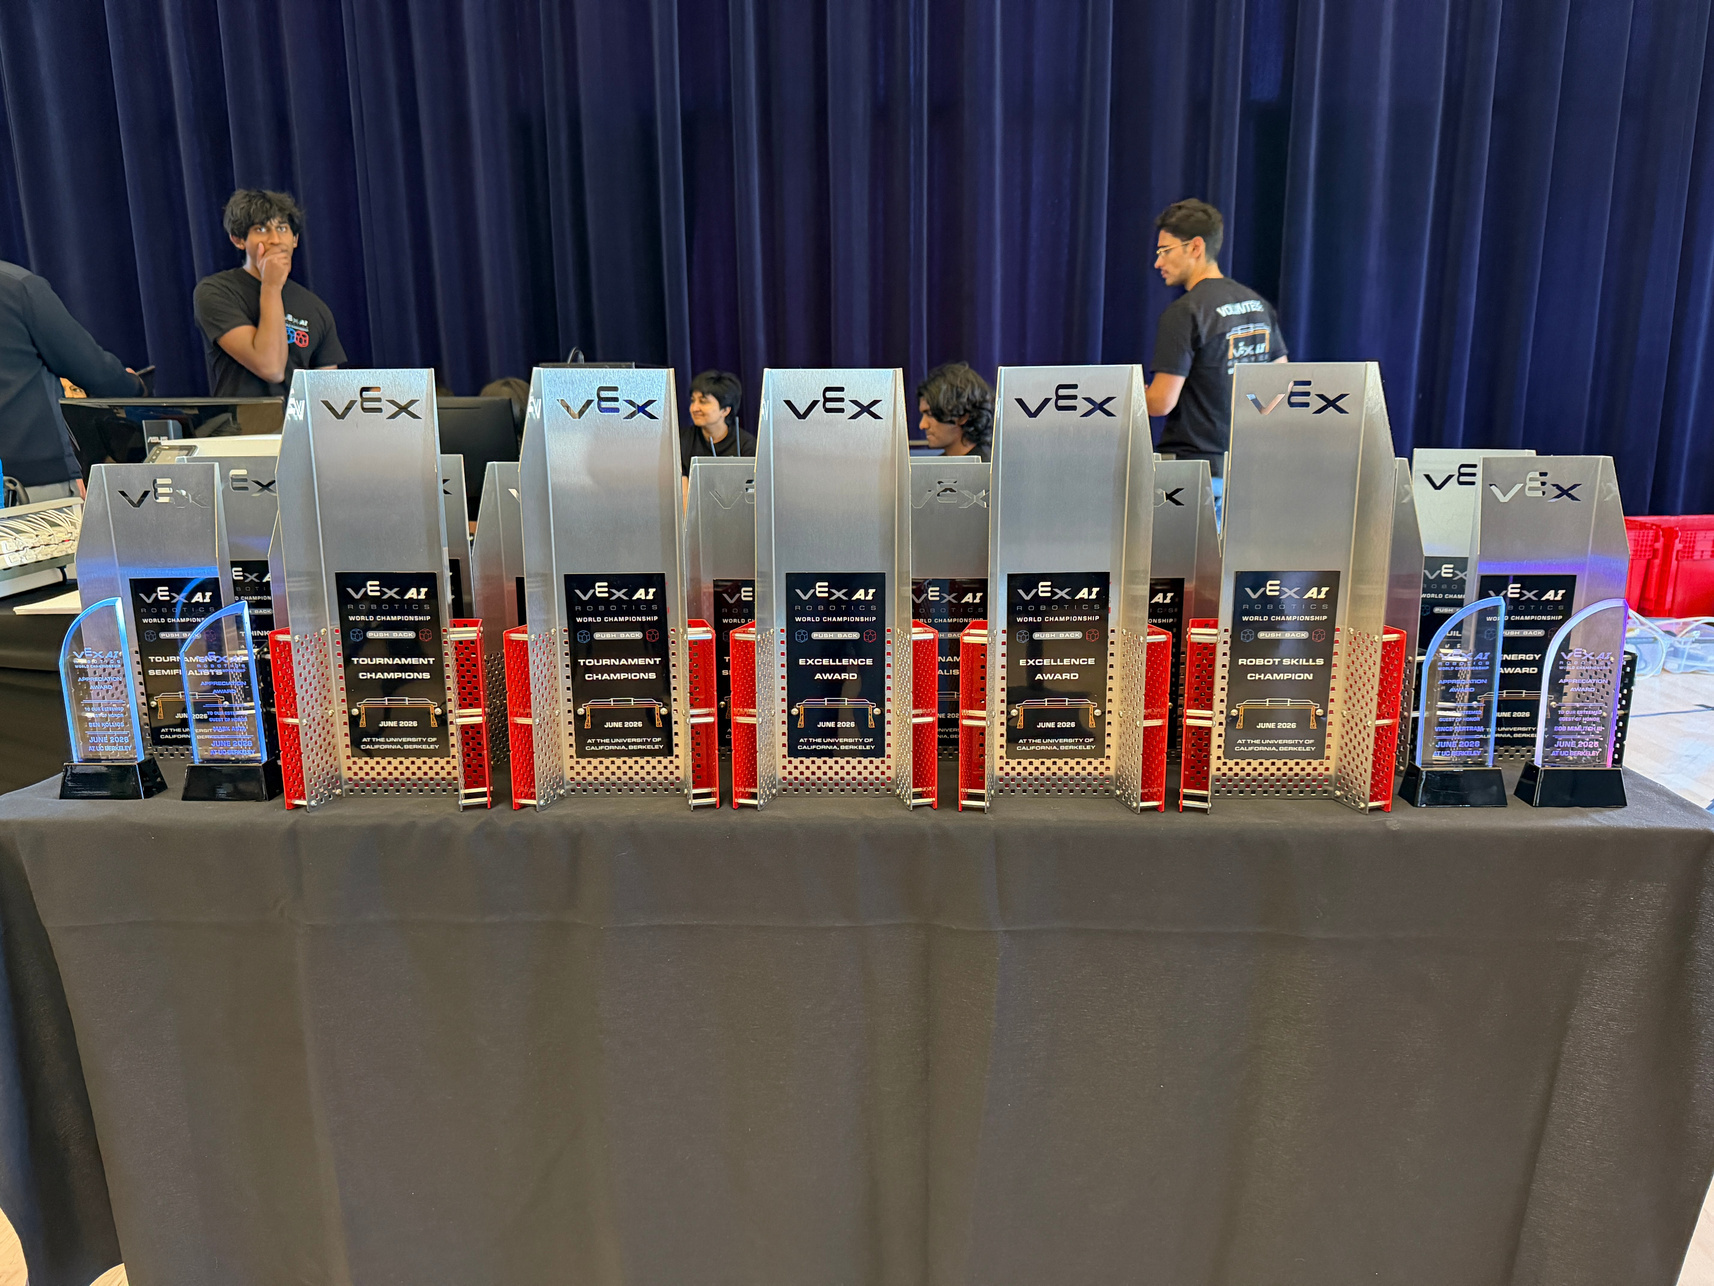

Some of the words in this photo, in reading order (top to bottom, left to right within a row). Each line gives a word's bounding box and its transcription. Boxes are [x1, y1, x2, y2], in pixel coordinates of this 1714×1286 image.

[320, 387, 422, 420] VEX
[557, 386, 659, 420] VEX
[783, 386, 883, 420] VEX
[1014, 384, 1117, 418] VEX
[1246, 380, 1350, 415] VEX
[1423, 464, 1478, 490] VE
[1488, 472, 1582, 502] VEX
[1423, 564, 1467, 580] VEX
[139, 586, 188, 603] VEX
[191, 592, 212, 603] AI
[346, 580, 401, 599] VEX
[403, 588, 428, 599] AI
[574, 582, 629, 600] VEX
[632, 588, 656, 600] AI
[795, 582, 849, 600] VEX
[851, 589, 876, 600] AI
[911, 587, 958, 604] VEX
[961, 593, 983, 603] AI
[1017, 581, 1072, 600] VEX
[1074, 587, 1100, 600] AI
[1150, 593, 1174, 603] AI
[1244, 580, 1300, 599] VEX
[1303, 587, 1329, 599] AI
[1541, 589, 1566, 601] AI
[73, 647, 104, 659] VEX
[106, 651, 119, 659] AI
[578, 658, 661, 666] TOURNAMENT
[1019, 658, 1095, 666] EXCELLENCE
[1474, 652, 1490, 660] AI
[1501, 653, 1542, 661] NERGY
[1561, 648, 1594, 659] VEX
